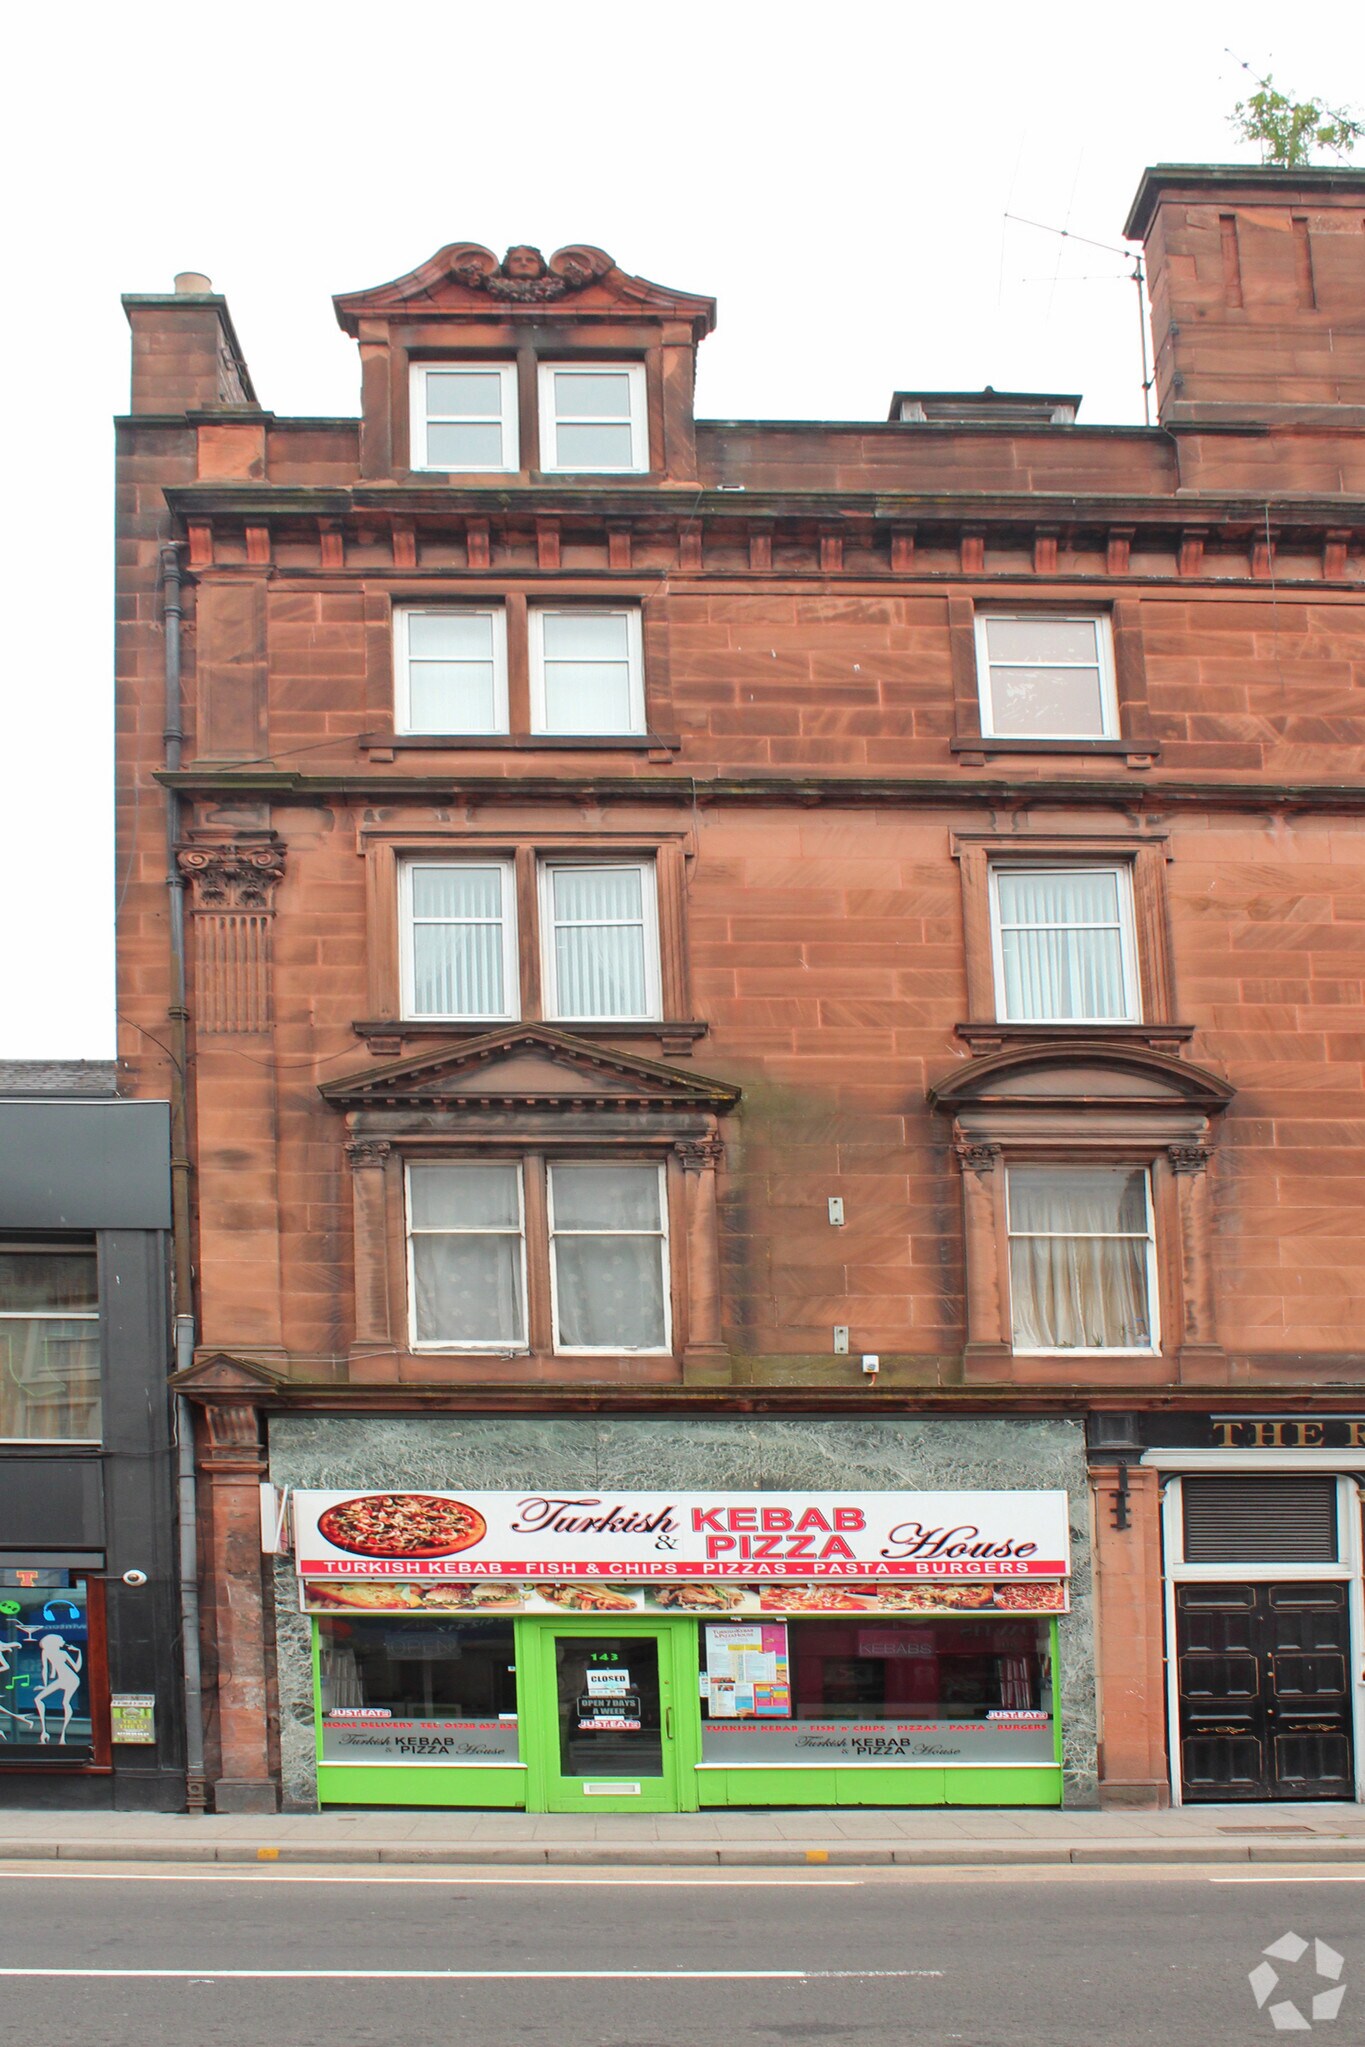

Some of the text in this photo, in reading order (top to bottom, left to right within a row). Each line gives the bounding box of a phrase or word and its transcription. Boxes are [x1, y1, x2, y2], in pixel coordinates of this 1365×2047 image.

[1212, 1422, 1325, 1447] THE
[511, 1497, 867, 1533] Turkish KEBAB
[654, 1522, 1038, 1560] & PIZZA House
[323, 1561, 420, 1573] TURKISH
[428, 1561, 502, 1573] KEBAB
[525, 1562, 576, 1574] FISH
[585, 1562, 600, 1574] &
[608, 1562, 678, 1574] CHIPS
[703, 1563, 787, 1574] PIZZAS
[813, 1563, 890, 1574] PASTA
[916, 1562, 1029, 1574] BURGERS
[859, 1641, 932, 1655] KEBABS
[591, 1653, 618, 1661] 143
[338, 1733, 455, 1746] Turkish KEBAB
[795, 1735, 911, 1747] Turkish KEBAB
[401, 1745, 450, 1754] PIZZA
[456, 1743, 505, 1755] House
[857, 1746, 906, 1755] PIZZA
[912, 1743, 960, 1756] House
